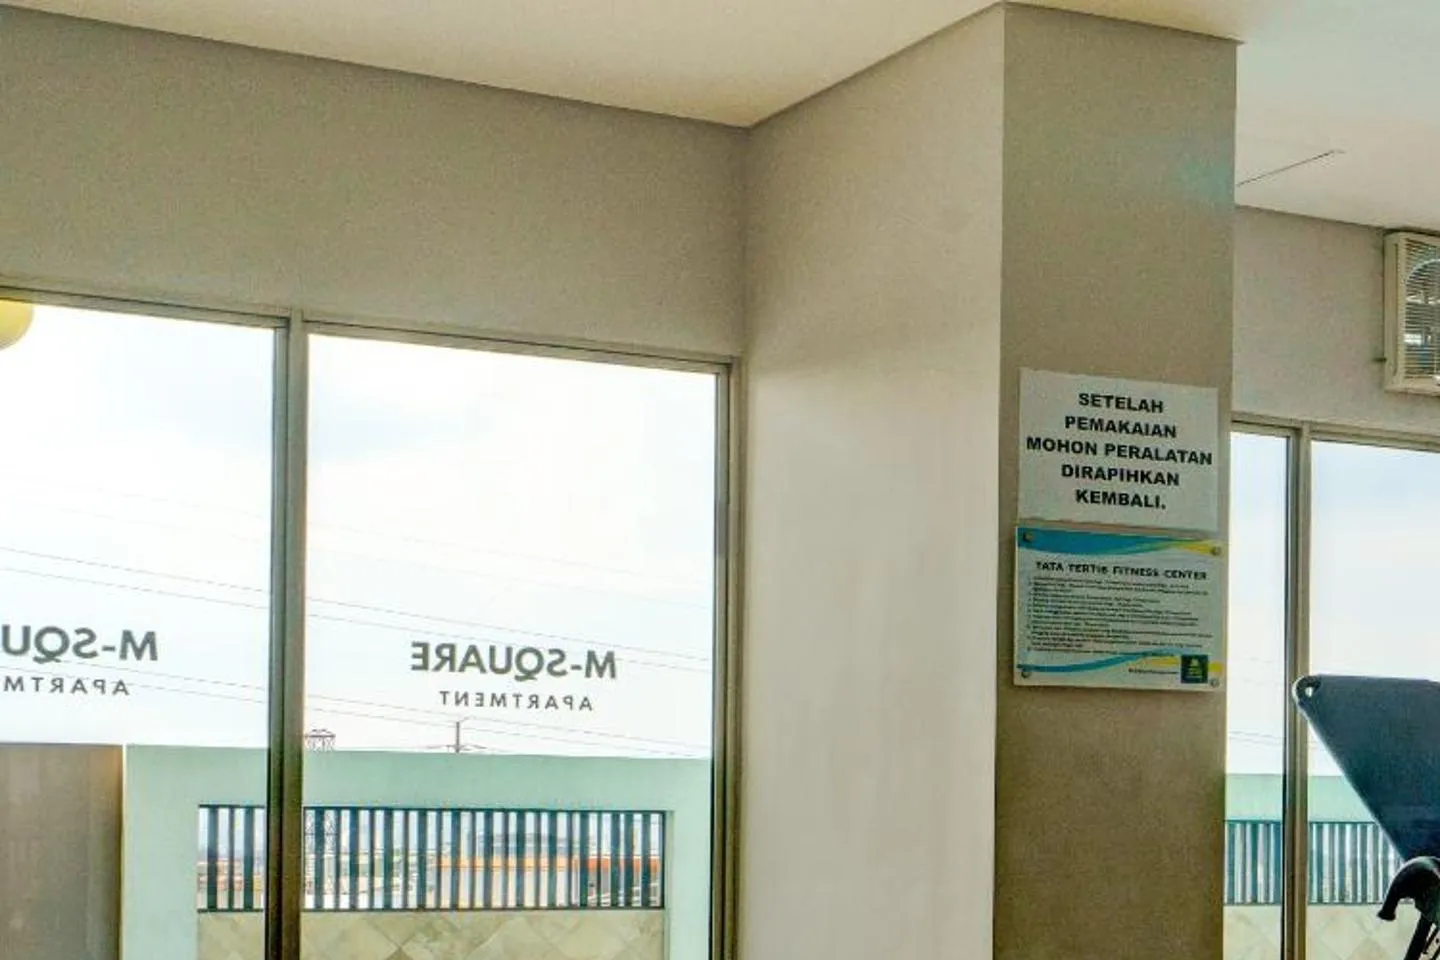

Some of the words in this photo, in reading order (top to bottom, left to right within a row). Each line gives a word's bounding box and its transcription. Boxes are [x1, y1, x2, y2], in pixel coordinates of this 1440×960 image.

[1078, 392, 1164, 413] SETELAH
[1064, 415, 1177, 438] PEMAKAIAN
[1026, 436, 1098, 456] MOHON
[1104, 443, 1213, 465] PERALATAN
[1061, 463, 1180, 486] DIRAPIHKAN
[1075, 488, 1166, 510] KEMBALI.
[1035, 561, 1064, 573] TATA
[1112, 565, 1161, 578] FITNESS
[1163, 569, 1208, 581] CENTER
